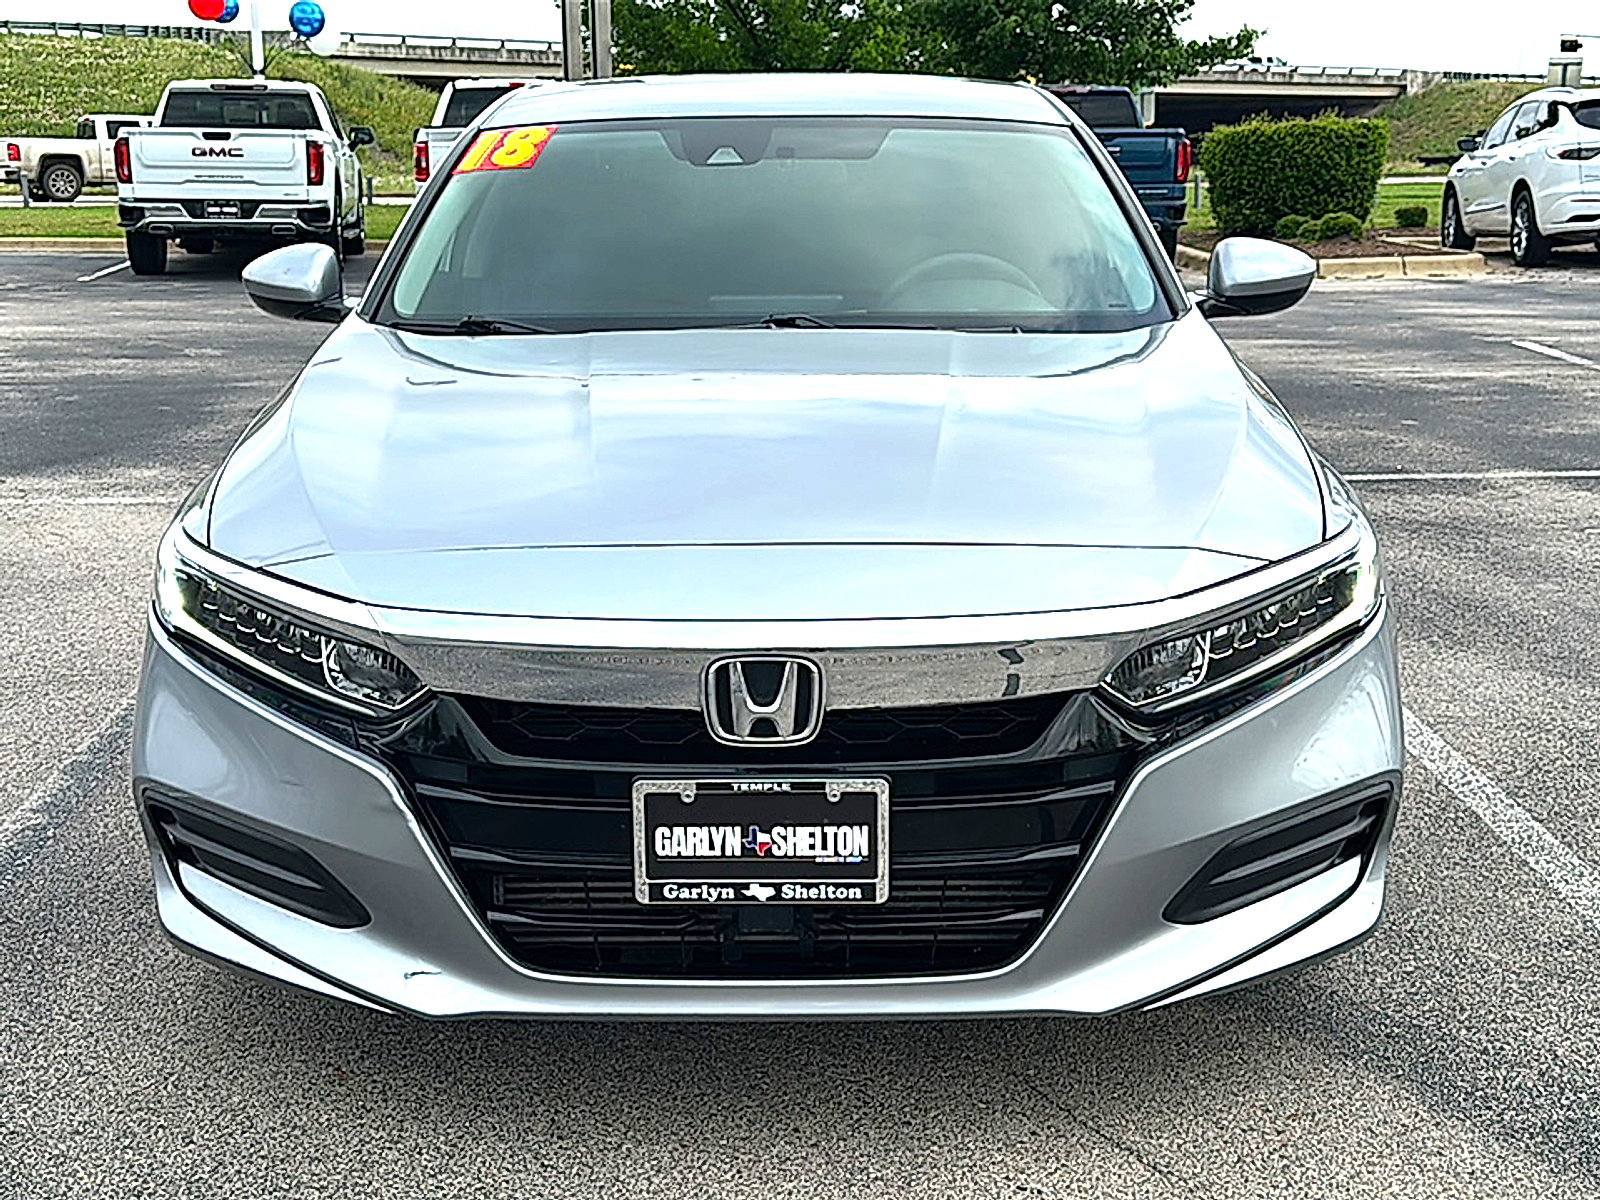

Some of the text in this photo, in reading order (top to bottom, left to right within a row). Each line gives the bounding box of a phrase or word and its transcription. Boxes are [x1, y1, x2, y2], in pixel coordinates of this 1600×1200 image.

[191, 147, 244, 158] GMC
[457, 127, 548, 171] 18
[731, 783, 792, 792] TEMPLE
[654, 825, 869, 857] GARLYN SHELTON
[663, 884, 862, 904] Garlyn Shelton
